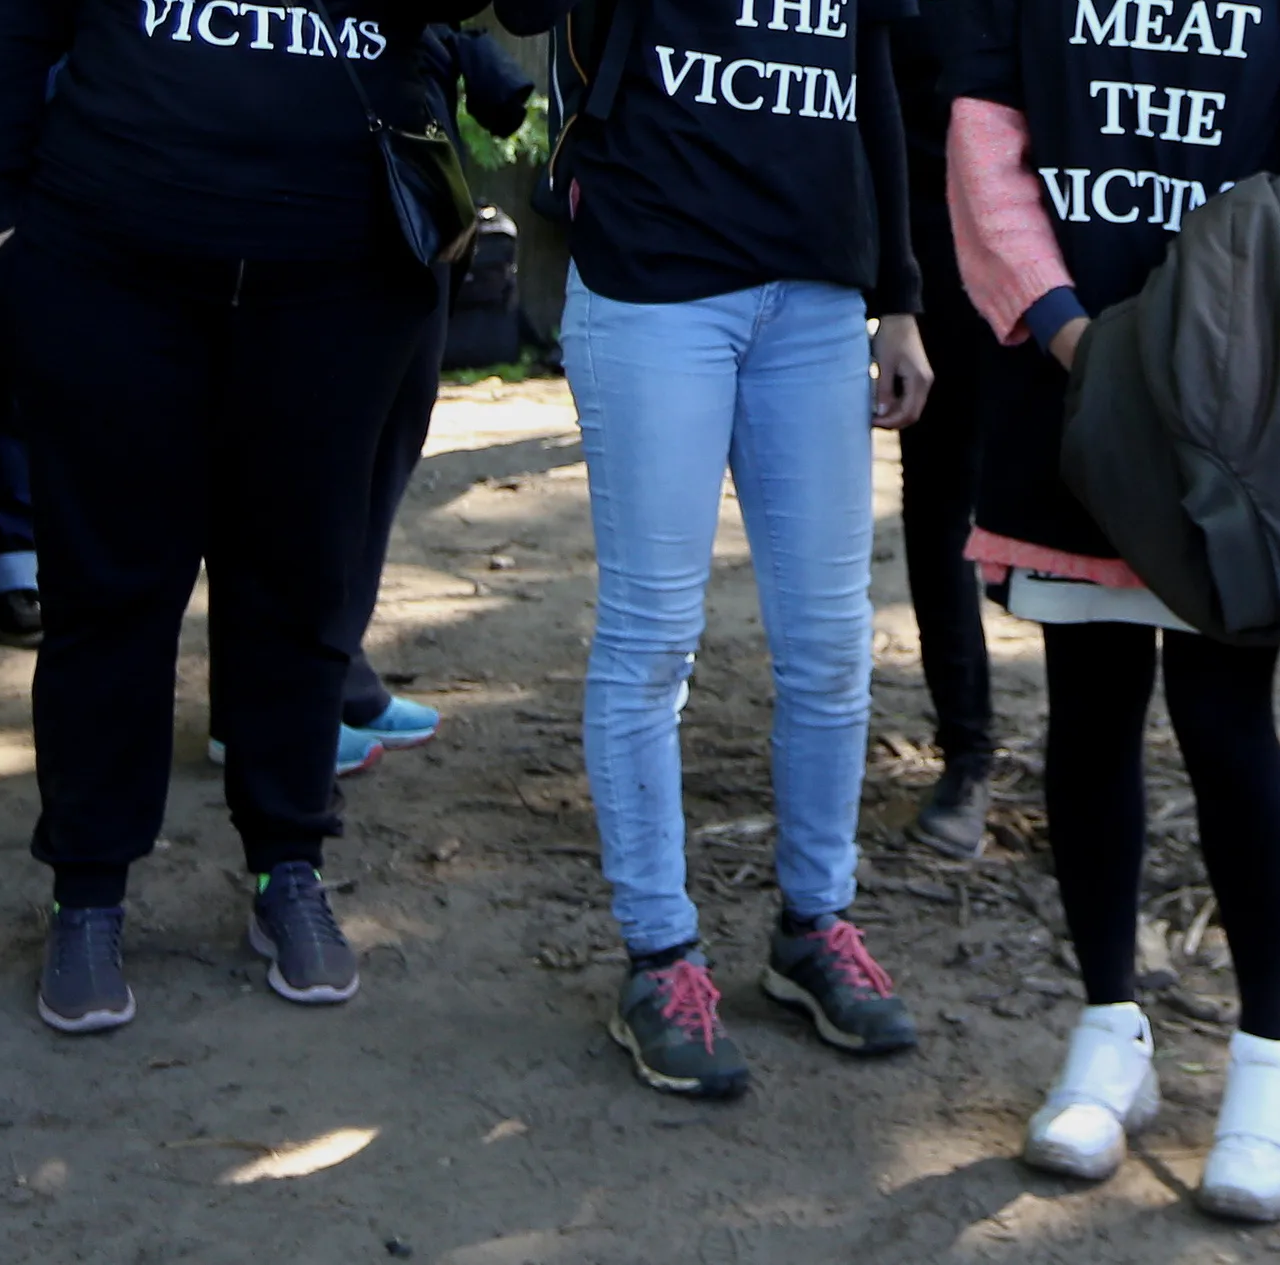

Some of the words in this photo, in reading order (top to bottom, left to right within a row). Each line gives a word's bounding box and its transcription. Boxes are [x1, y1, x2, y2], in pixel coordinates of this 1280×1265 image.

[655, 45, 858, 122] VICTIM
[1089, 80, 1226, 146] THE
[1038, 167, 1236, 232] VICTI
